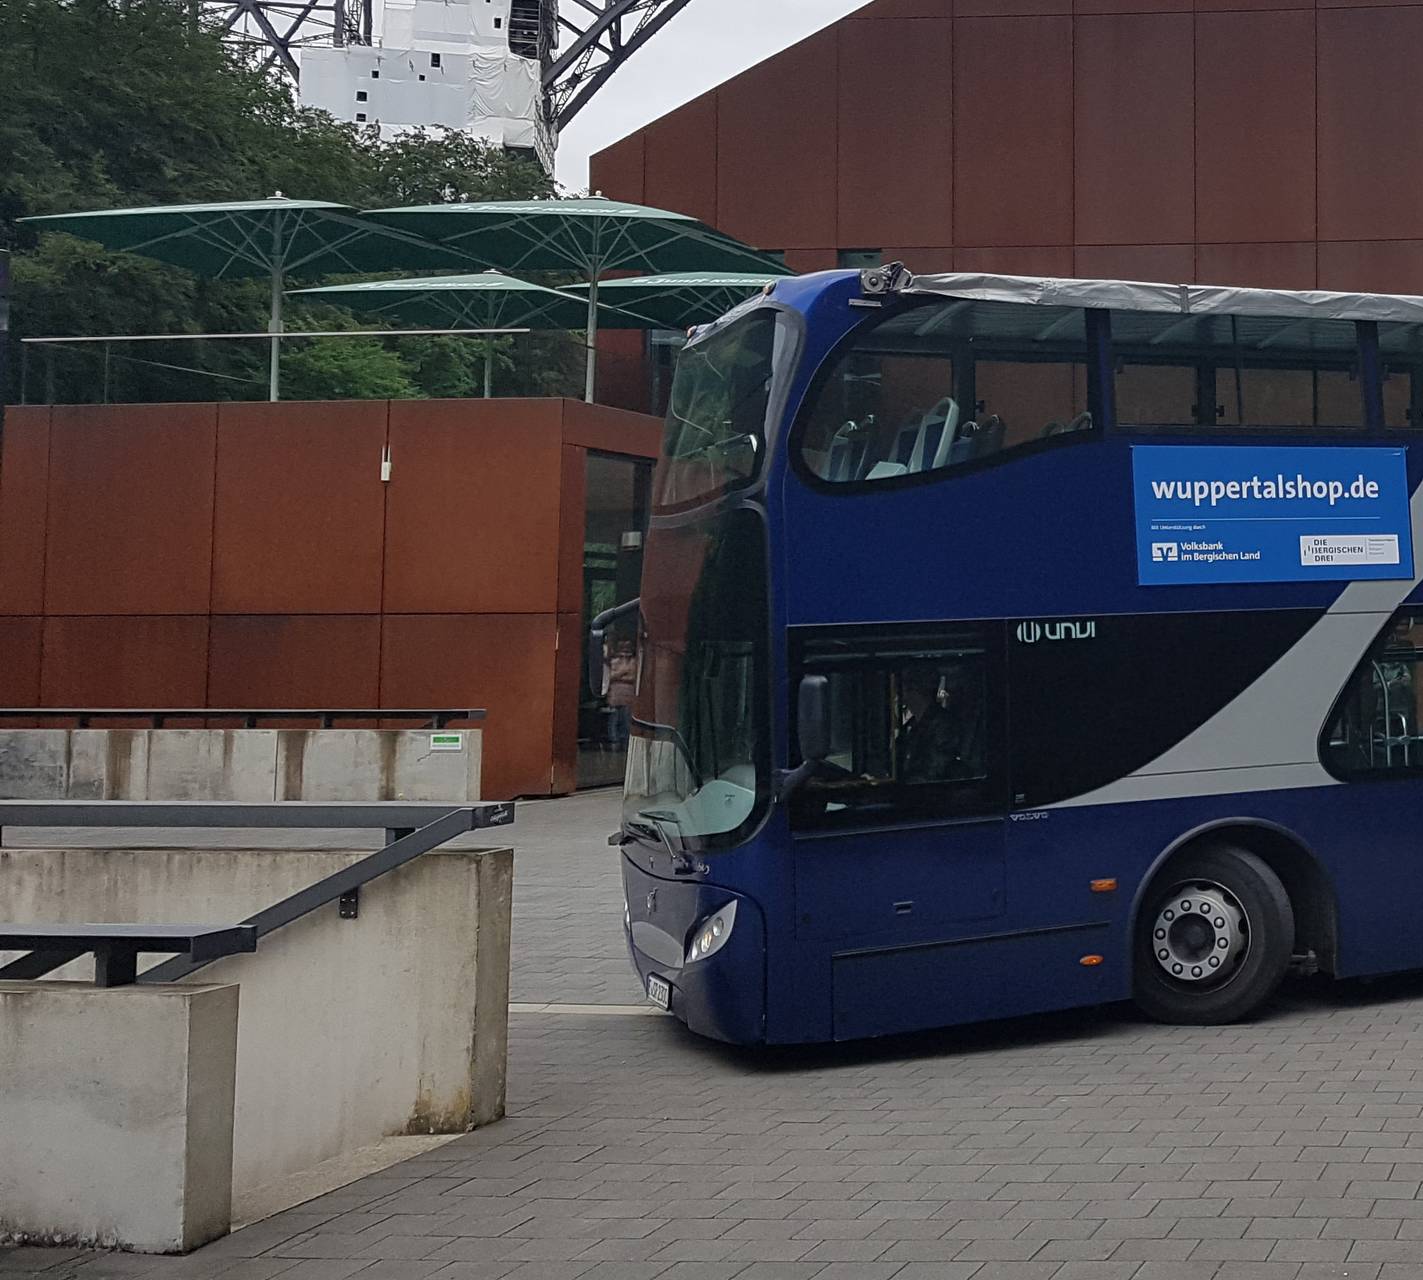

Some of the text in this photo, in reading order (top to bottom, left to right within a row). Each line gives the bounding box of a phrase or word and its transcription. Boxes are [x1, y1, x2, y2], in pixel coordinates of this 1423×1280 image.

[1151, 474, 1379, 506] wuppertalshop.de
[1180, 541, 1223, 551] Volksbank
[1181, 551, 1260, 563] im Bergischen Land
[1314, 554, 1333, 562] DREI
